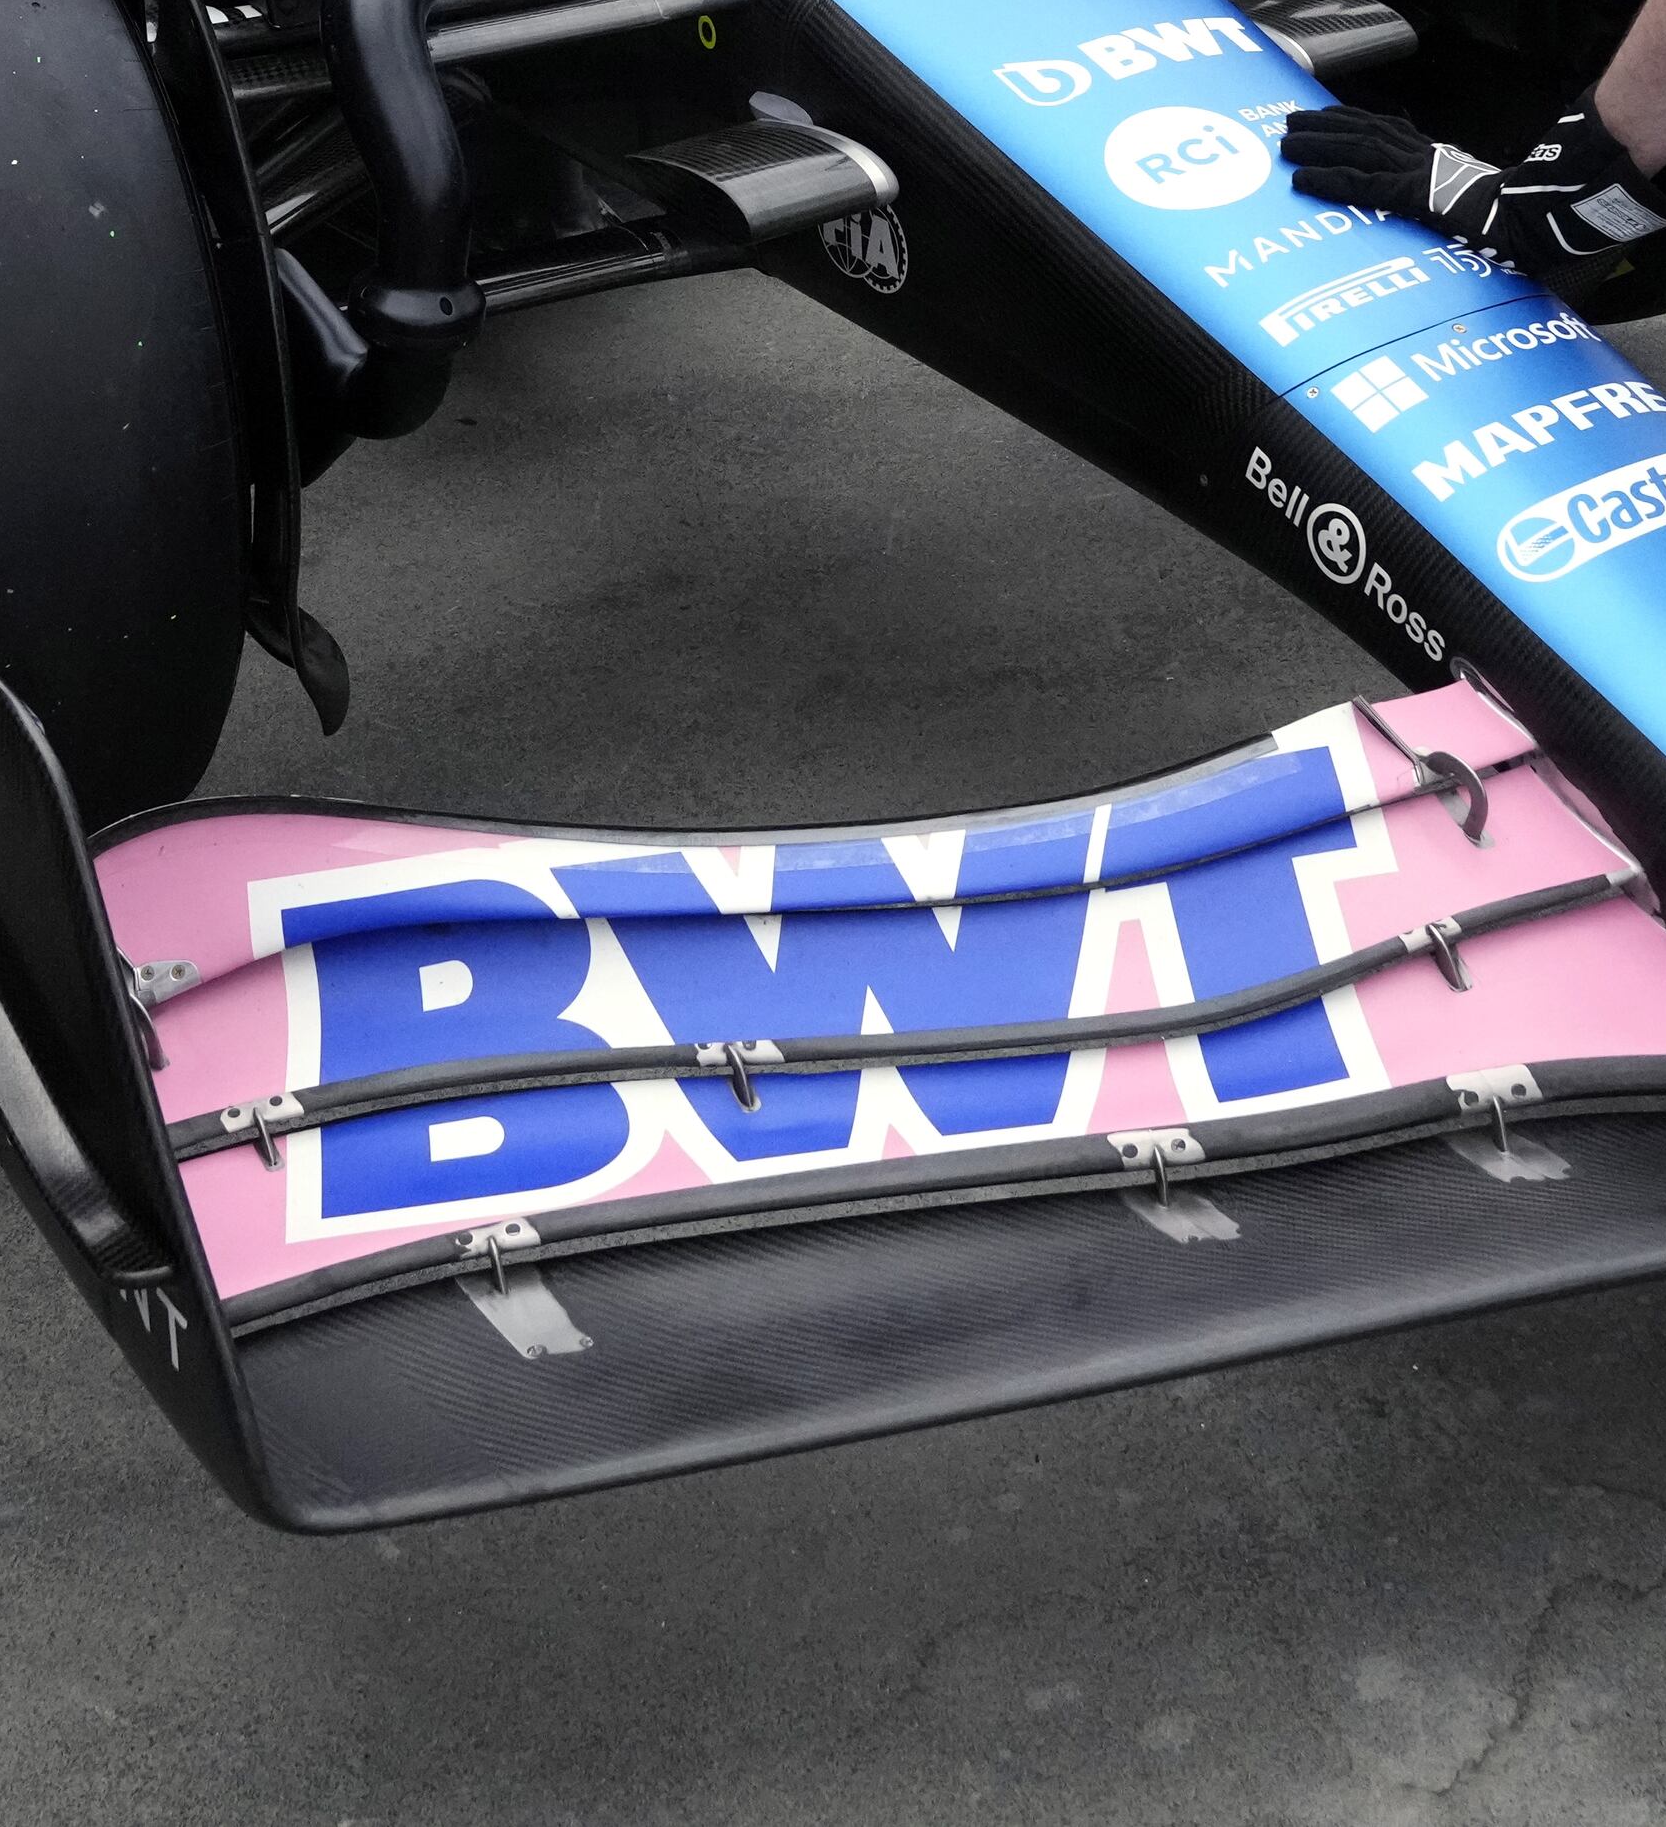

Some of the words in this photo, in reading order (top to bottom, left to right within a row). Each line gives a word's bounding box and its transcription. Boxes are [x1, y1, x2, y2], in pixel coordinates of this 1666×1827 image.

[1078, 17, 1263, 80] BWT
[1238, 99, 1305, 124] BANK
[1203, 203, 1402, 288] MANDIA
[1259, 257, 1431, 347] PIRELLI
[1412, 312, 1602, 382] Microsoft
[1245, 445, 1310, 528] Bell
[1312, 510, 1359, 579] &
[1363, 561, 1447, 662] Ross
[263, 729, 1378, 1229] BWT
